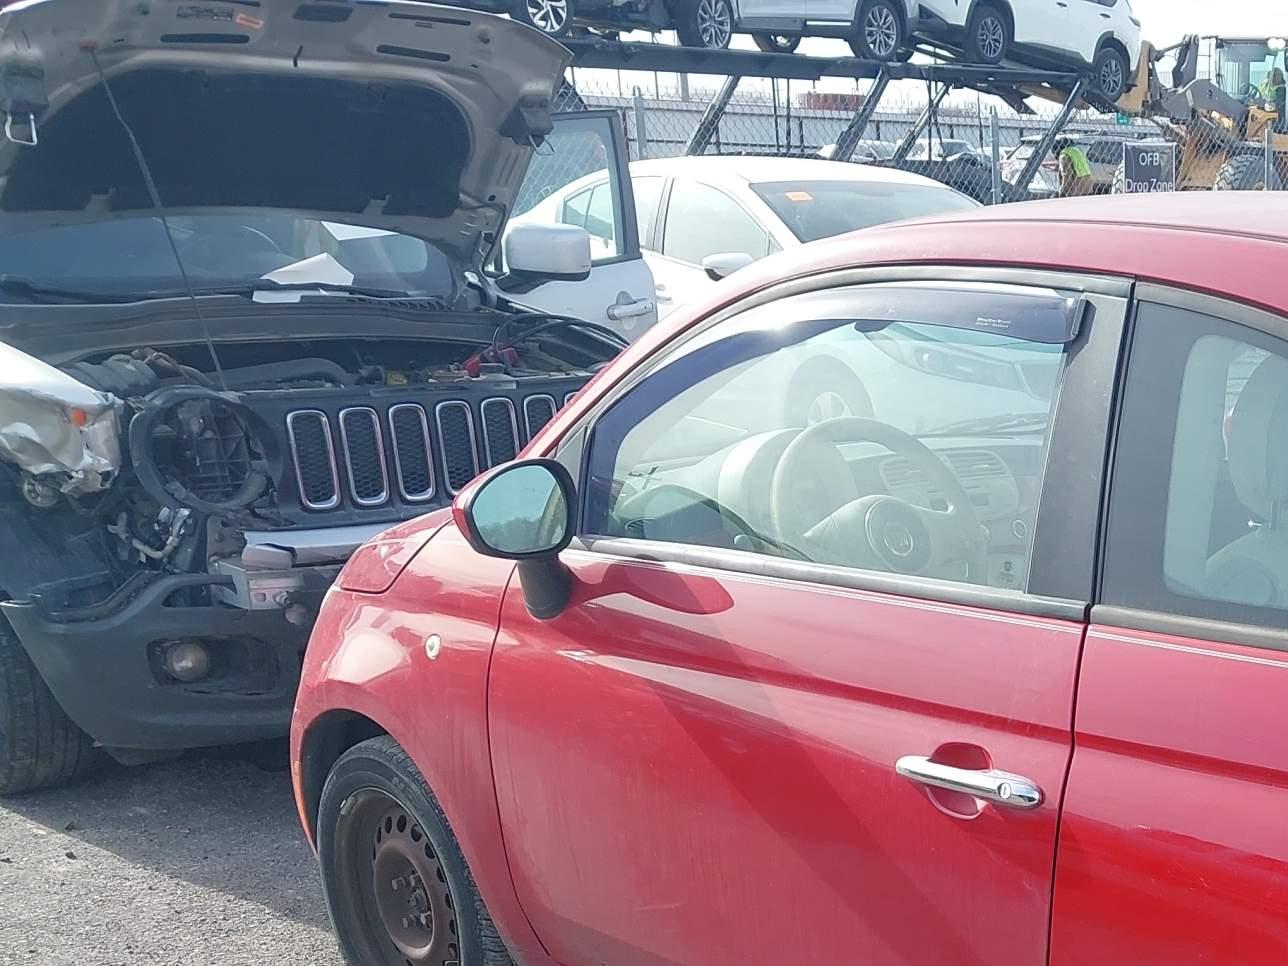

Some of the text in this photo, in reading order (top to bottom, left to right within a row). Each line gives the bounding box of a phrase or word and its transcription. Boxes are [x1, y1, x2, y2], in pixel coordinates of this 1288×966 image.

[1138, 152, 1160, 166] OFB
[1125, 177, 1173, 193] Drop Zone
